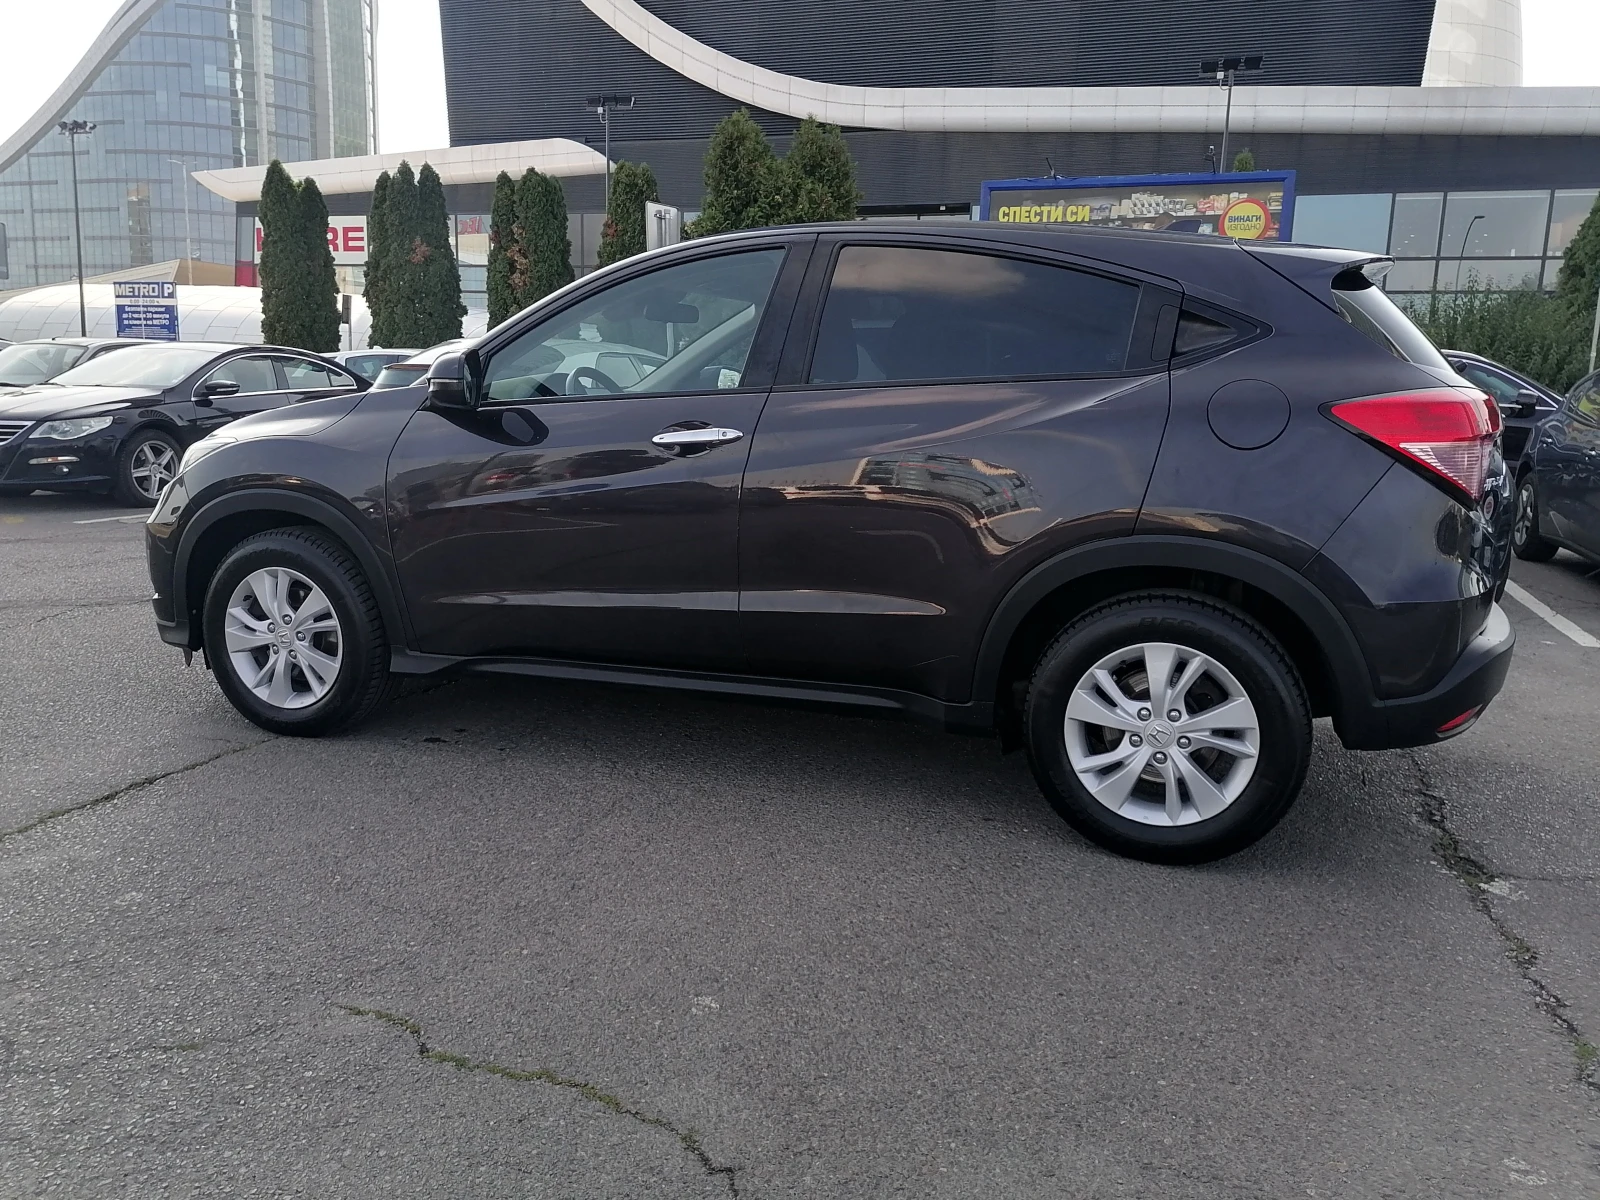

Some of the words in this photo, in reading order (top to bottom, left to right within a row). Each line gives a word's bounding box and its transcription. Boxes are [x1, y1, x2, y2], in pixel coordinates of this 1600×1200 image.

[998, 205, 1063, 223] СПЕСТИ
[1066, 205, 1091, 222] СИ
[1228, 215, 1262, 223] ВИНАГИ
[1227, 223, 1261, 231] ИЗГОДНО
[115, 284, 159, 296] METRO
[163, 284, 173, 297] P
